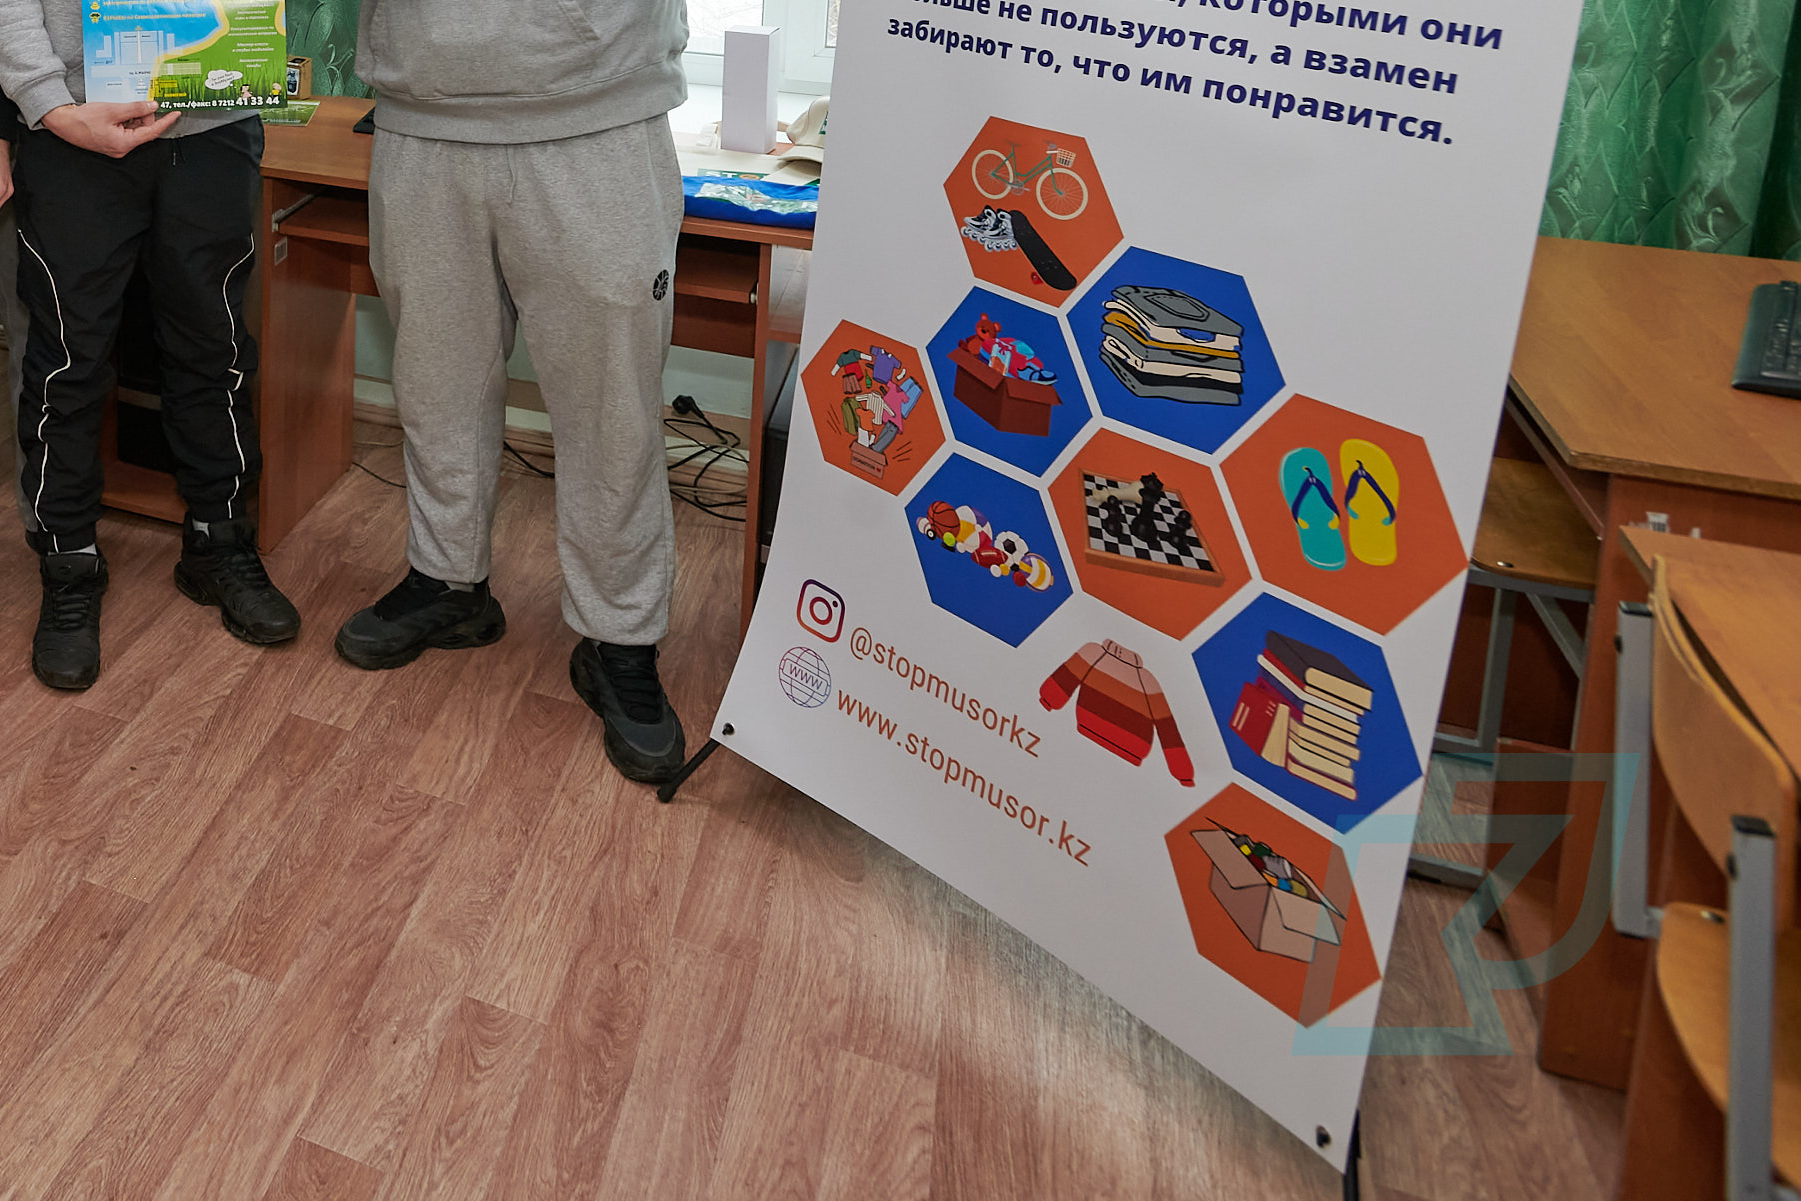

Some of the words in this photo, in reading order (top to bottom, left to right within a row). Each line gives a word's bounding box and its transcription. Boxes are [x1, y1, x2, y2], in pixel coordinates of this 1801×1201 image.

[999, 0, 1032, 22] не
[1041, 7, 1258, 65] пользуются,
[1270, 44, 1292, 66] а
[1303, 49, 1458, 94] взамен
[1420, 18, 1503, 50] они
[236, 97, 248, 106] 41
[251, 97, 264, 105] 33
[266, 96, 280, 105] 44
[887, 18, 1013, 53] забирают
[1021, 45, 1061, 74] то,
[1073, 55, 1131, 82] что
[1140, 67, 1192, 94] им
[1202, 78, 1453, 145] понравится.
[789, 663, 823, 691] www
[850, 627, 1041, 758] @stopmusorkz
[838, 689, 1091, 867] www.stopmusor.kz
